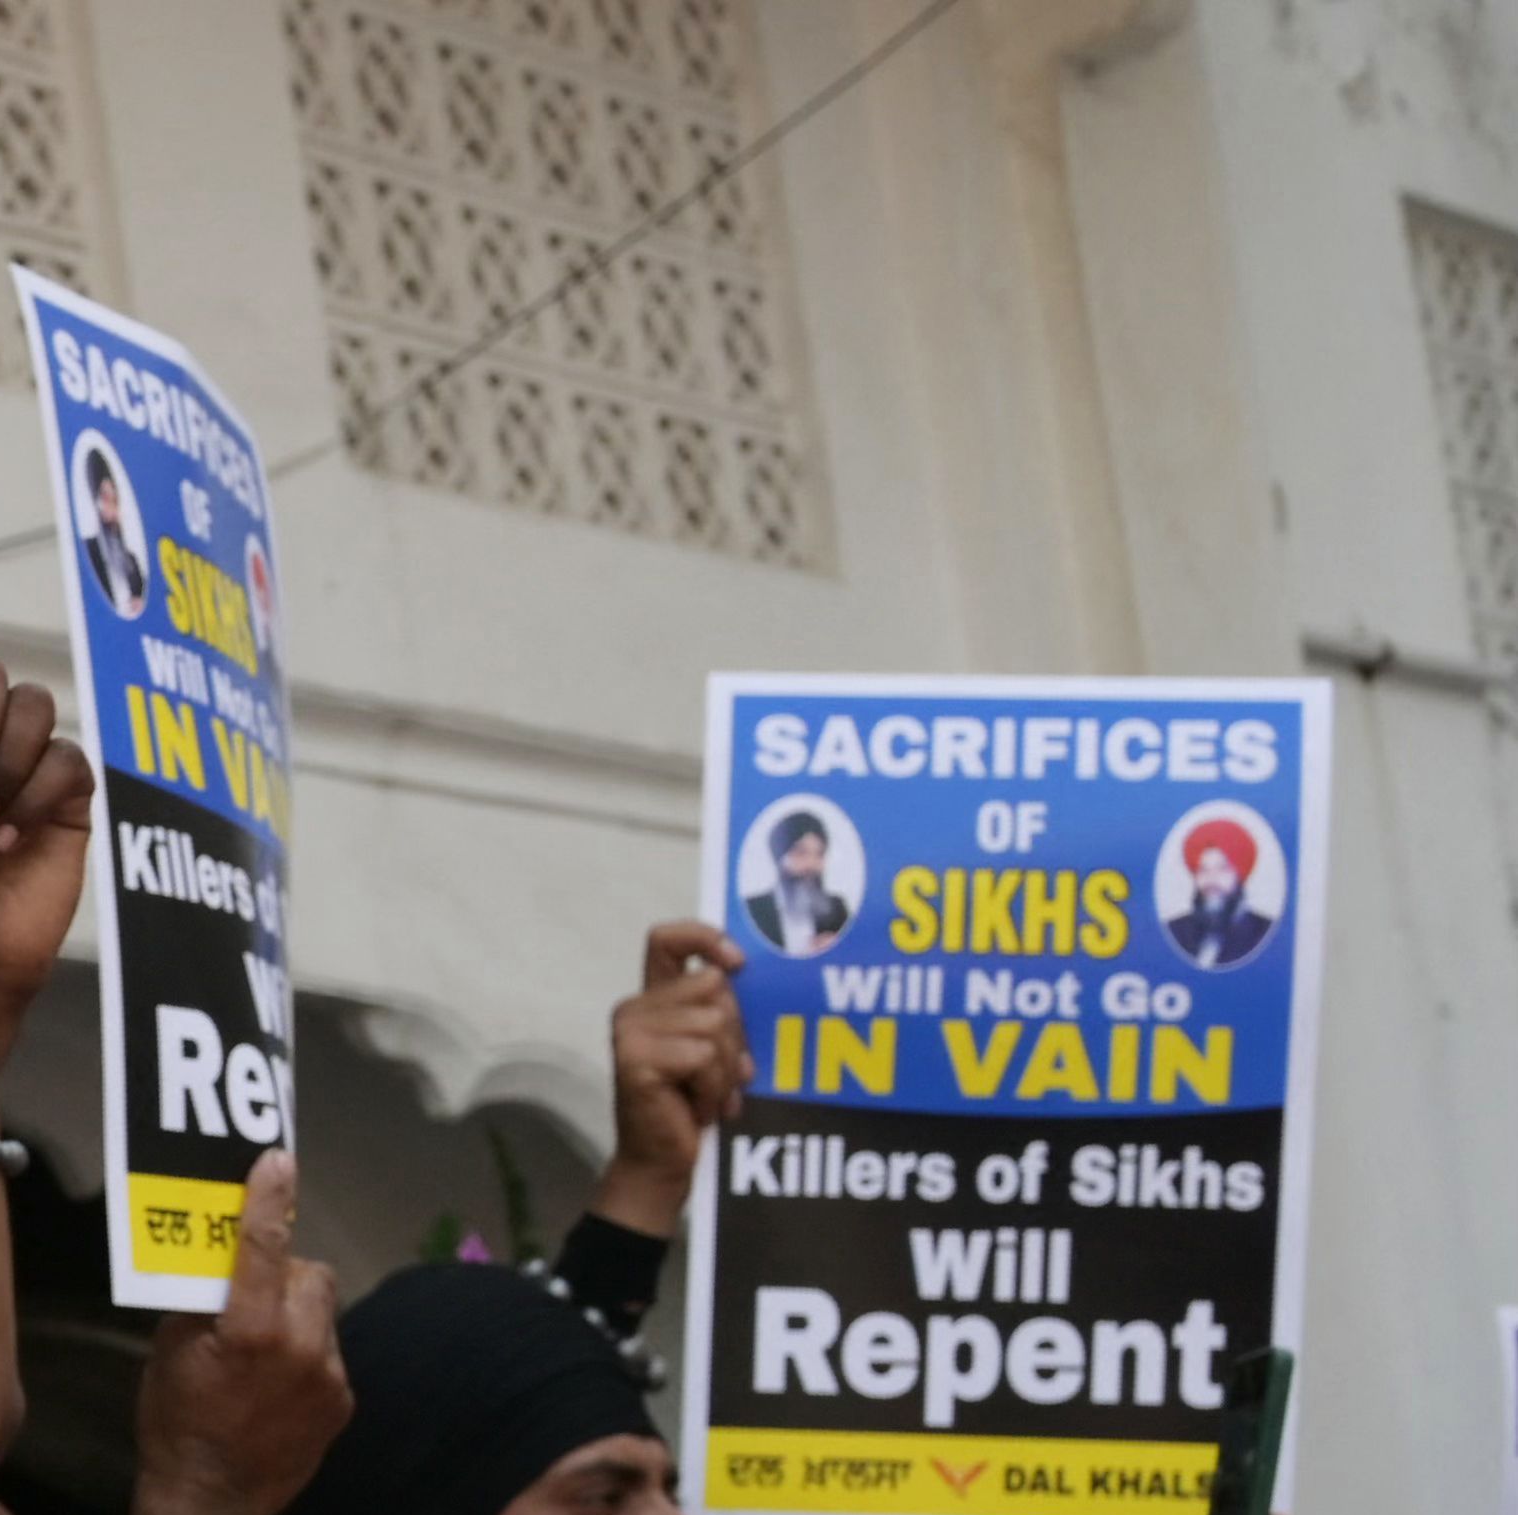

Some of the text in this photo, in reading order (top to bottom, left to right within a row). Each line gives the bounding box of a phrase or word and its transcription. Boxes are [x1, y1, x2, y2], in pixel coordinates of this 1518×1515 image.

[180, 479, 212, 541] OF
[126, 685, 206, 791] IN
[753, 714, 1279, 783] SACRIFICES
[975, 801, 1047, 853] OF
[119, 821, 255, 921] Killers
[888, 865, 1131, 957] SIKHS
[823, 965, 1191, 1021] Will Not Go
[773, 1015, 1234, 1105] IN VAIN
[729, 1135, 1265, 1212] Killers of Sikhs
[909, 1227, 1072, 1304] Will
[752, 1285, 1227, 1428] Repent
[1003, 1465, 1072, 1497] DAL
